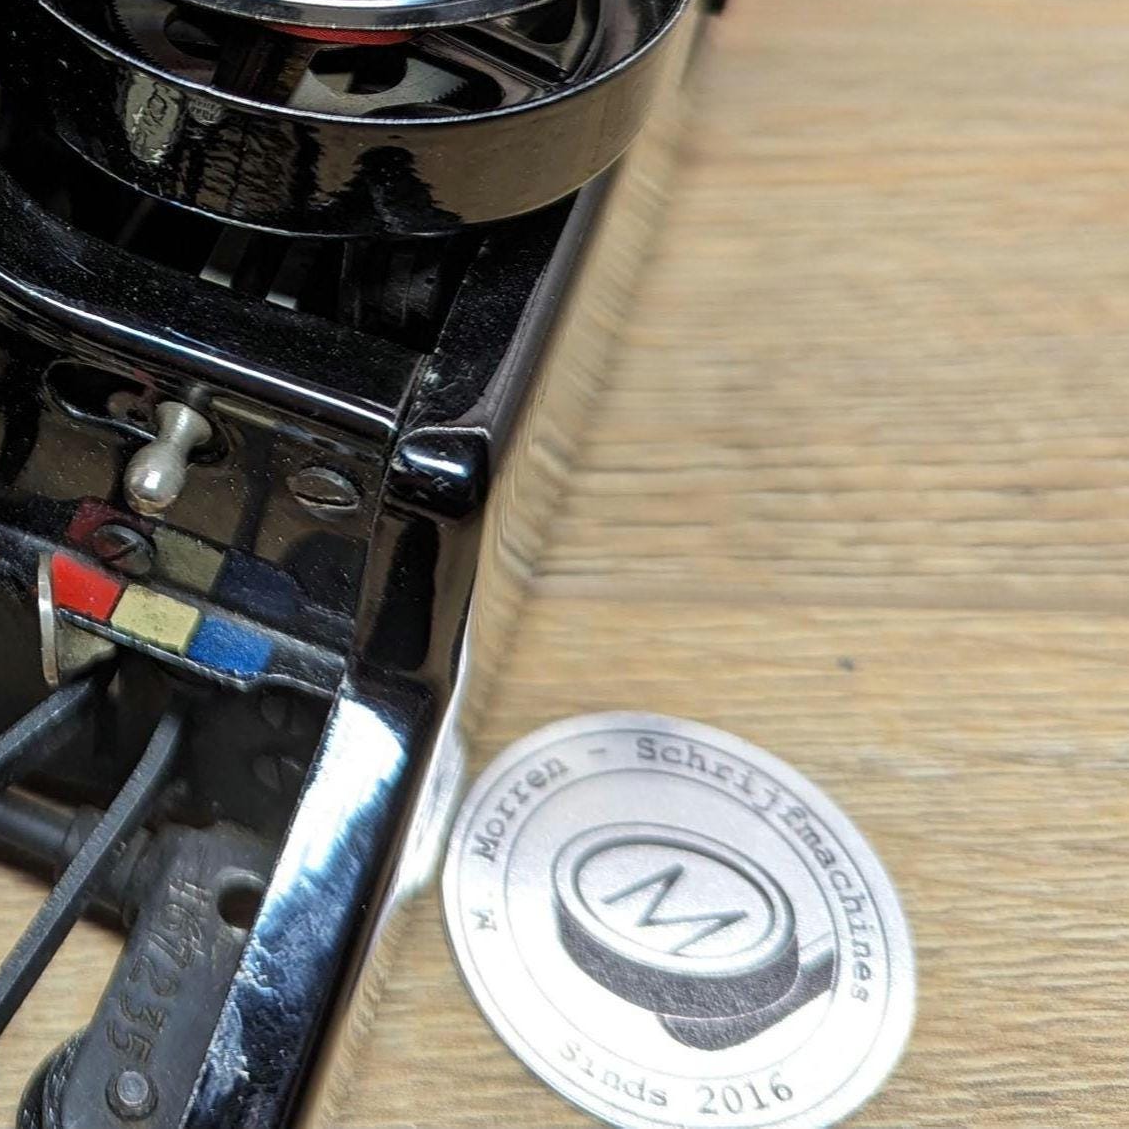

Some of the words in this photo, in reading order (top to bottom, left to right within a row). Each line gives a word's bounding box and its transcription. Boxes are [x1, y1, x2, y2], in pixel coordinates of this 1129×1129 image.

[469, 755, 569, 863] Morren
[634, 735, 874, 1004] Schrijfmachines
[558, 1039, 670, 1108] Sinds
[696, 1071, 795, 1116] 2016
